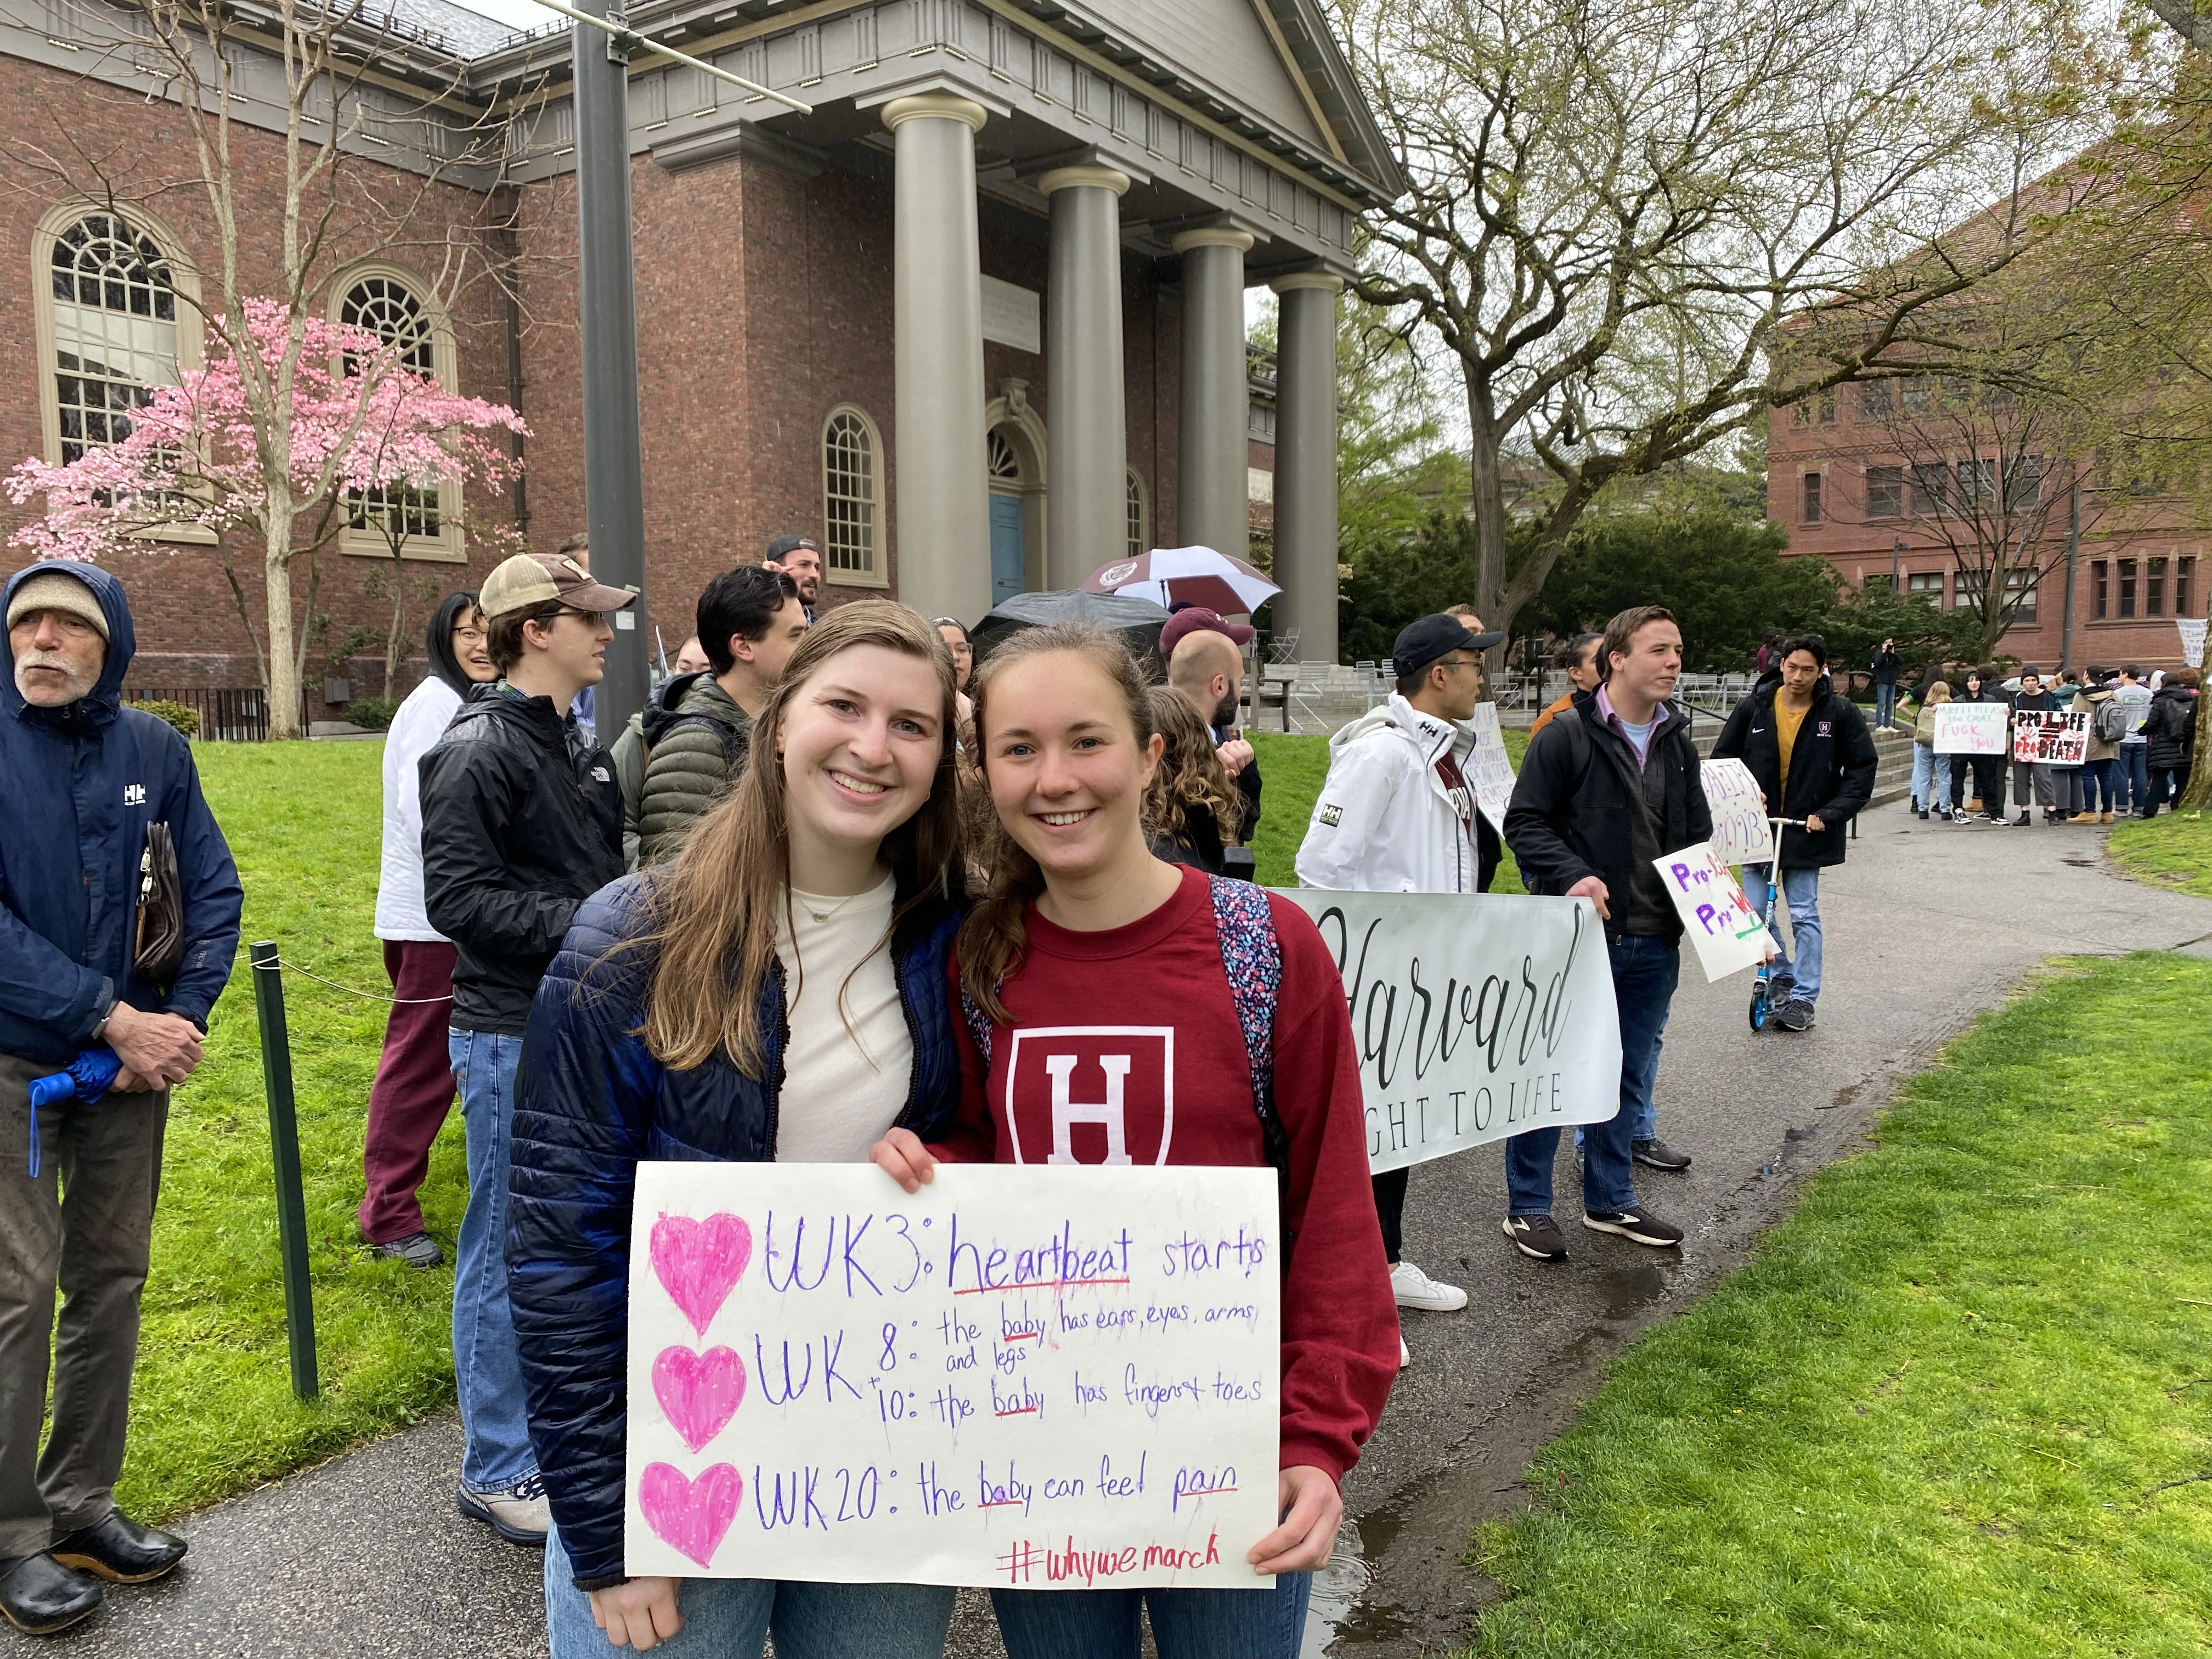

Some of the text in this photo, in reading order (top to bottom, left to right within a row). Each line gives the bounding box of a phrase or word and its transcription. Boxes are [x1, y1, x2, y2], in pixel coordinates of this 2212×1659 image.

[1419, 720, 1438, 737] HH
[1483, 704, 1496, 726] UP
[1942, 723, 1984, 738] FUCK
[2018, 712, 2086, 731] PRO LIFE
[1476, 730, 1492, 747] HOSE
[1467, 761, 1512, 787] PEAK FOR
[1322, 805, 1342, 819] HH
[1317, 902, 1584, 1090] Harvard
[1046, 1054, 1131, 1165] H
[1364, 1073, 1562, 1157] GHT TO LIFE
[949, 1213, 1133, 1294] heartbeat
[1163, 1230, 1265, 1277] starts
[755, 1329, 863, 1405] WK
[936, 1307, 982, 1345] the
[1001, 1300, 1046, 1348] baby
[1060, 1299, 1088, 1333] has
[946, 1341, 1026, 1375] and legs
[929, 1384, 975, 1429] the
[990, 1375, 1044, 1420] baby
[1075, 1370, 1108, 1404] has
[1211, 1371, 1262, 1401] toes
[916, 1460, 966, 1516] the
[980, 1460, 1031, 1518] baby
[1044, 1477, 1084, 1500] can
[1096, 1450, 1147, 1499] feel
[1173, 1466, 1239, 1513] pain
